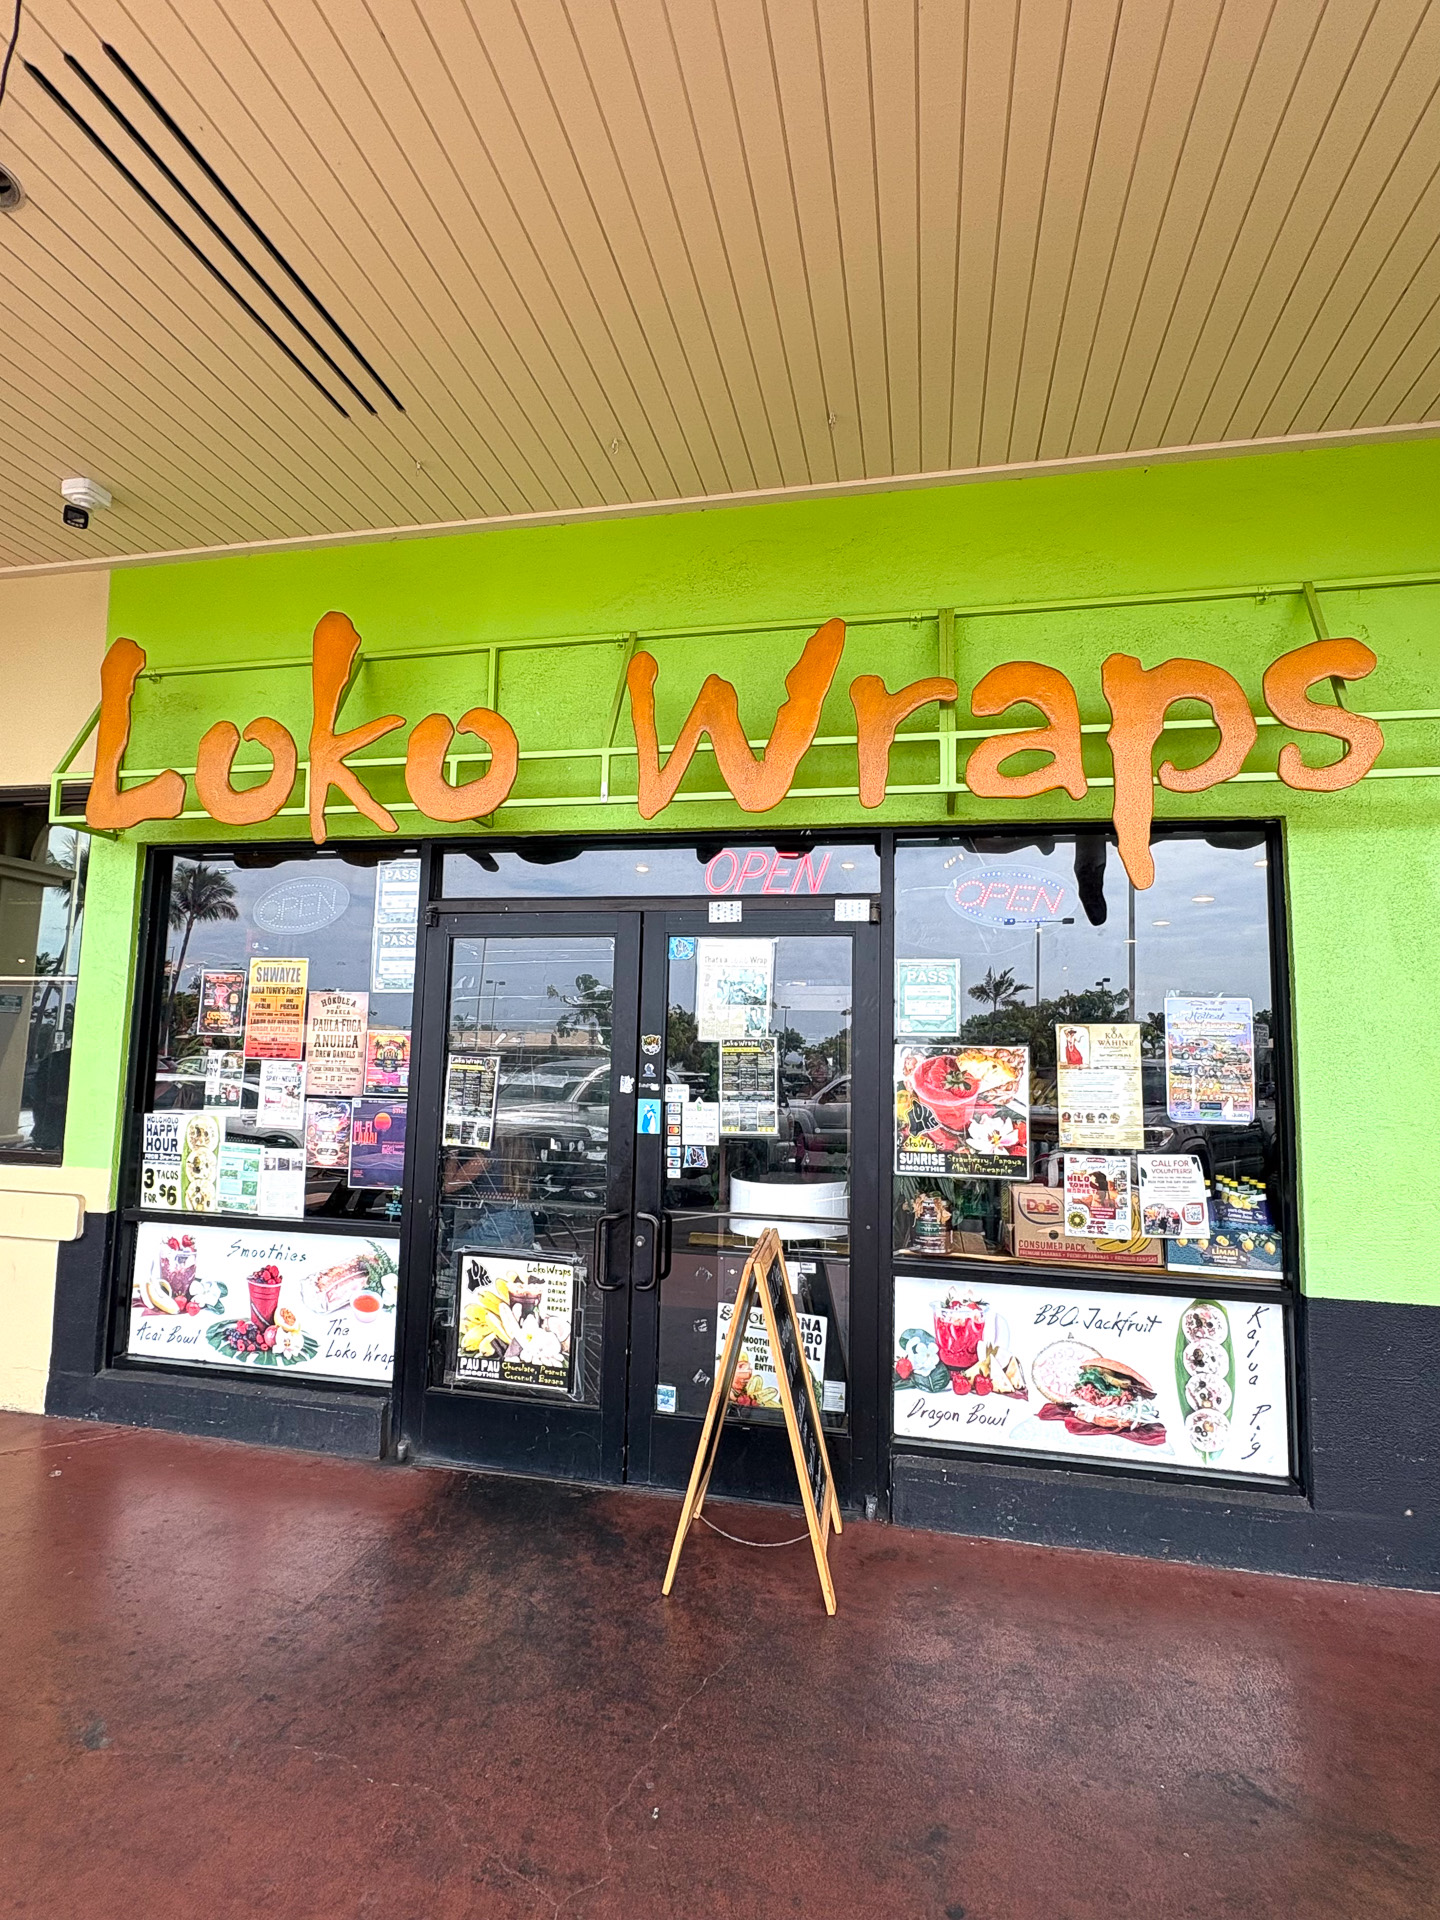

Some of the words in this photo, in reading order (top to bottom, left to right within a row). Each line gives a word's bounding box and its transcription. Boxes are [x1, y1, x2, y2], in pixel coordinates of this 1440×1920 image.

[86, 611, 519, 844] Loko
[628, 618, 1385, 890] Wraps
[384, 869, 418, 881] PASS
[704, 849, 832, 895] OPEN
[955, 880, 1065, 914] OPEN
[259, 888, 337, 923] OPEN
[382, 934, 415, 946] PASS
[256, 967, 302, 983] SHWAYZE
[906, 970, 949, 984] PASS
[312, 1017, 340, 1032] PAULA
[340, 1018, 362, 1033] FUGA
[313, 1034, 359, 1049] ANUHEA
[315, 1049, 331, 1058] DREW
[333, 1050, 356, 1059] DANIELS
[146, 1123, 178, 1138] HAPPY
[146, 1137, 178, 1153] HOUR
[899, 1152, 946, 1166] SUNRISE
[1151, 1159, 1172, 1168] CALL
[1173, 1159, 1190, 1168] FOR
[899, 1165, 946, 1173] SMOOTHIE
[143, 1167, 155, 1189] 3
[156, 1169, 179, 1181] TACOS
[1067, 1174, 1090, 1182] HILO
[143, 1192, 158, 1204] FOR
[158, 1183, 177, 1206] $6
[227, 1239, 307, 1263] Smoothies
[1018, 1239, 1062, 1251] CONSUMER
[1065, 1242, 1086, 1252] PACK
[547, 1296, 567, 1304] ENJOY
[546, 1305, 570, 1313] REPEAT
[326, 1317, 350, 1336] The
[1083, 1307, 1163, 1339] Jackfruit
[136, 1321, 162, 1343] Acai
[167, 1326, 201, 1346] Bowl
[1246, 1305, 1271, 1387] Kalua
[326, 1340, 357, 1360] Loko
[363, 1343, 395, 1371] Wrap
[754, 1354, 769, 1363] ANY
[460, 1357, 480, 1371] PAU
[480, 1359, 500, 1372] PAU
[906, 1397, 961, 1425] Dragon
[966, 1403, 1011, 1427] Bowl
[1241, 1403, 1273, 1461] Pig
